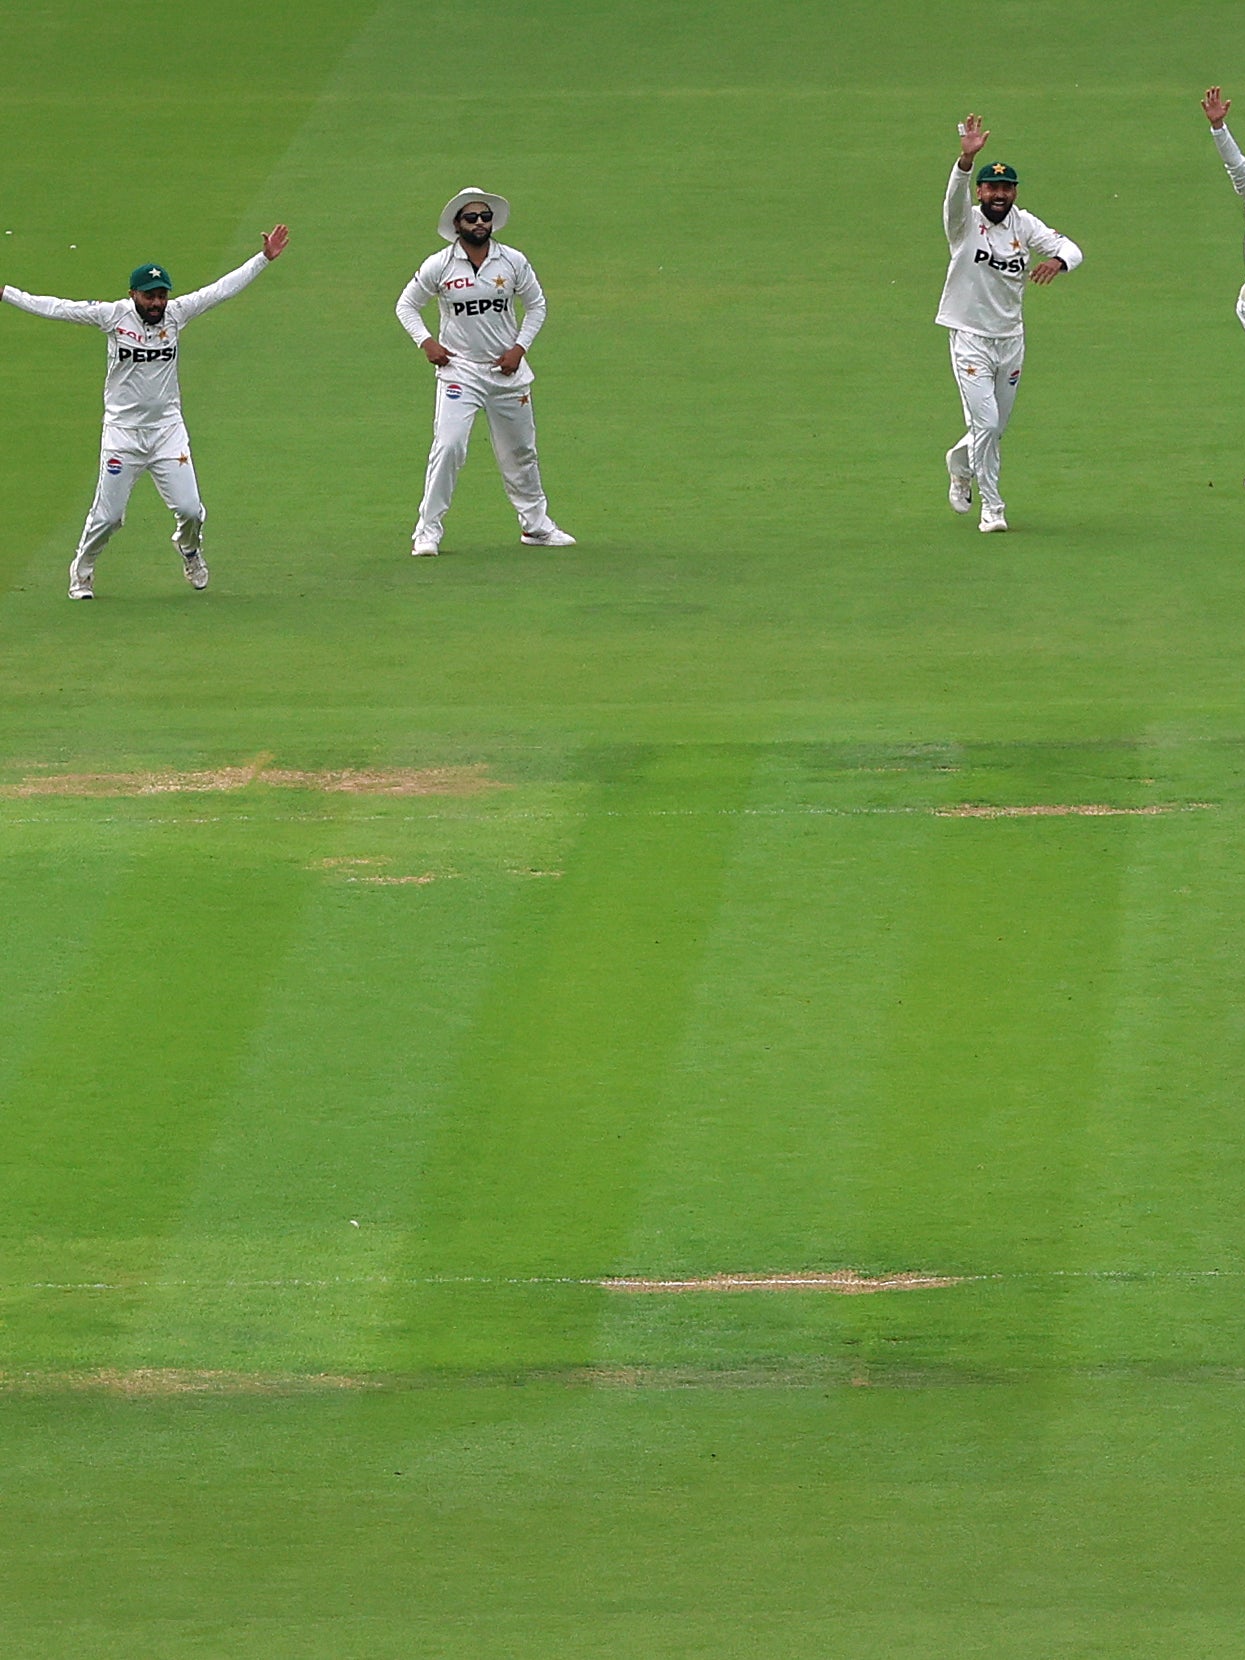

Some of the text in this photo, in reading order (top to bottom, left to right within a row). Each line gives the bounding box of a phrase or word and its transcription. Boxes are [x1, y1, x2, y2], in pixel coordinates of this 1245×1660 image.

[444, 278, 475, 290] TCL
[452, 298, 508, 316] PEPSI
[119, 346, 177, 363] PEPSI
